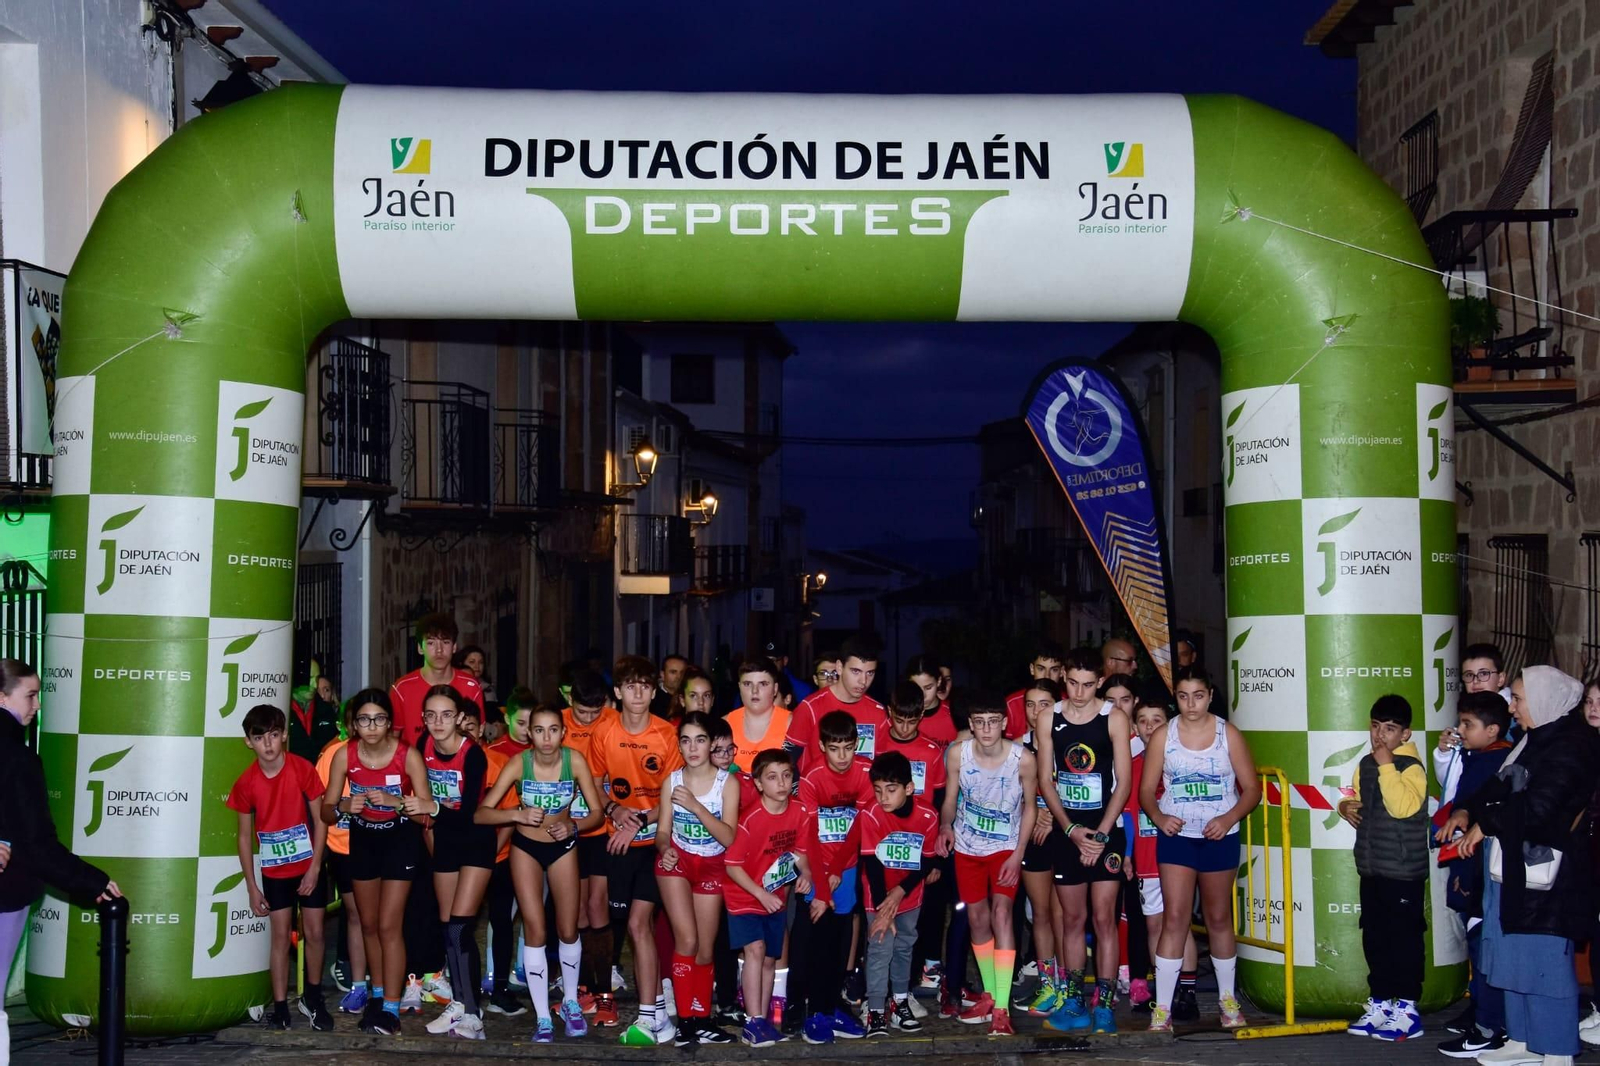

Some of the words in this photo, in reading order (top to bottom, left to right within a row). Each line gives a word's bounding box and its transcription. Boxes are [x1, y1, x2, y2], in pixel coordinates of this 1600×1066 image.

[484, 133, 817, 180] DIPUTACIÓN
[835, 141, 904, 180] DE
[916, 133, 1050, 181] JAÉN
[361, 177, 455, 218] Jaén
[1078, 182, 1168, 222] Jaén
[585, 195, 951, 236] DEPORTES
[363, 219, 407, 231] Paraíso
[411, 220, 456, 232] interior
[1078, 223, 1120, 234] Paraíso
[1124, 223, 1168, 234] interior
[42, 290, 60, 313] QUE
[108, 429, 198, 444] www.dipujaen.es
[1319, 433, 1403, 446] www.dipujaen.es
[252, 438, 300, 455] DIPUTACIÓN
[1235, 436, 1290, 453] DIPUTACIÓN
[252, 452, 266, 464] DE
[267, 454, 288, 467] JAÉN
[1235, 456, 1245, 467] DE
[1245, 453, 1268, 466] JAÉN
[120, 549, 200, 562] DIPUTACIÓN
[227, 553, 293, 570] DEPORTES
[1229, 552, 1290, 567] DEPORTES
[1340, 550, 1412, 562] DIPUTACIÓN
[119, 563, 137, 575] DE
[138, 563, 172, 576] JAÉN
[1340, 565, 1358, 576] DE
[1359, 564, 1390, 576] JAÉN
[94, 668, 191, 681] DEPORTES
[242, 672, 289, 684] DIPUTACIÓN
[1240, 666, 1295, 679] DIPUTACIÓN
[1321, 667, 1412, 678] DEPORTES
[241, 687, 256, 698] DE
[256, 685, 278, 698] JAÉN
[1240, 682, 1251, 693] DE
[1251, 680, 1274, 693] JAÉN
[107, 790, 189, 803] DIPUTACIÓN
[1065, 785, 1090, 801] 450
[1184, 783, 1209, 797] 414
[533, 794, 562, 810] 435
[106, 805, 124, 816] DE
[125, 804, 160, 817] JAÉN
[824, 816, 848, 833] 419
[977, 815, 996, 832] 411
[271, 839, 298, 857] 413
[886, 843, 911, 861] 458
[81, 912, 180, 924] DERTES
[230, 924, 245, 936] DE
[245, 922, 267, 935] JAÉN
